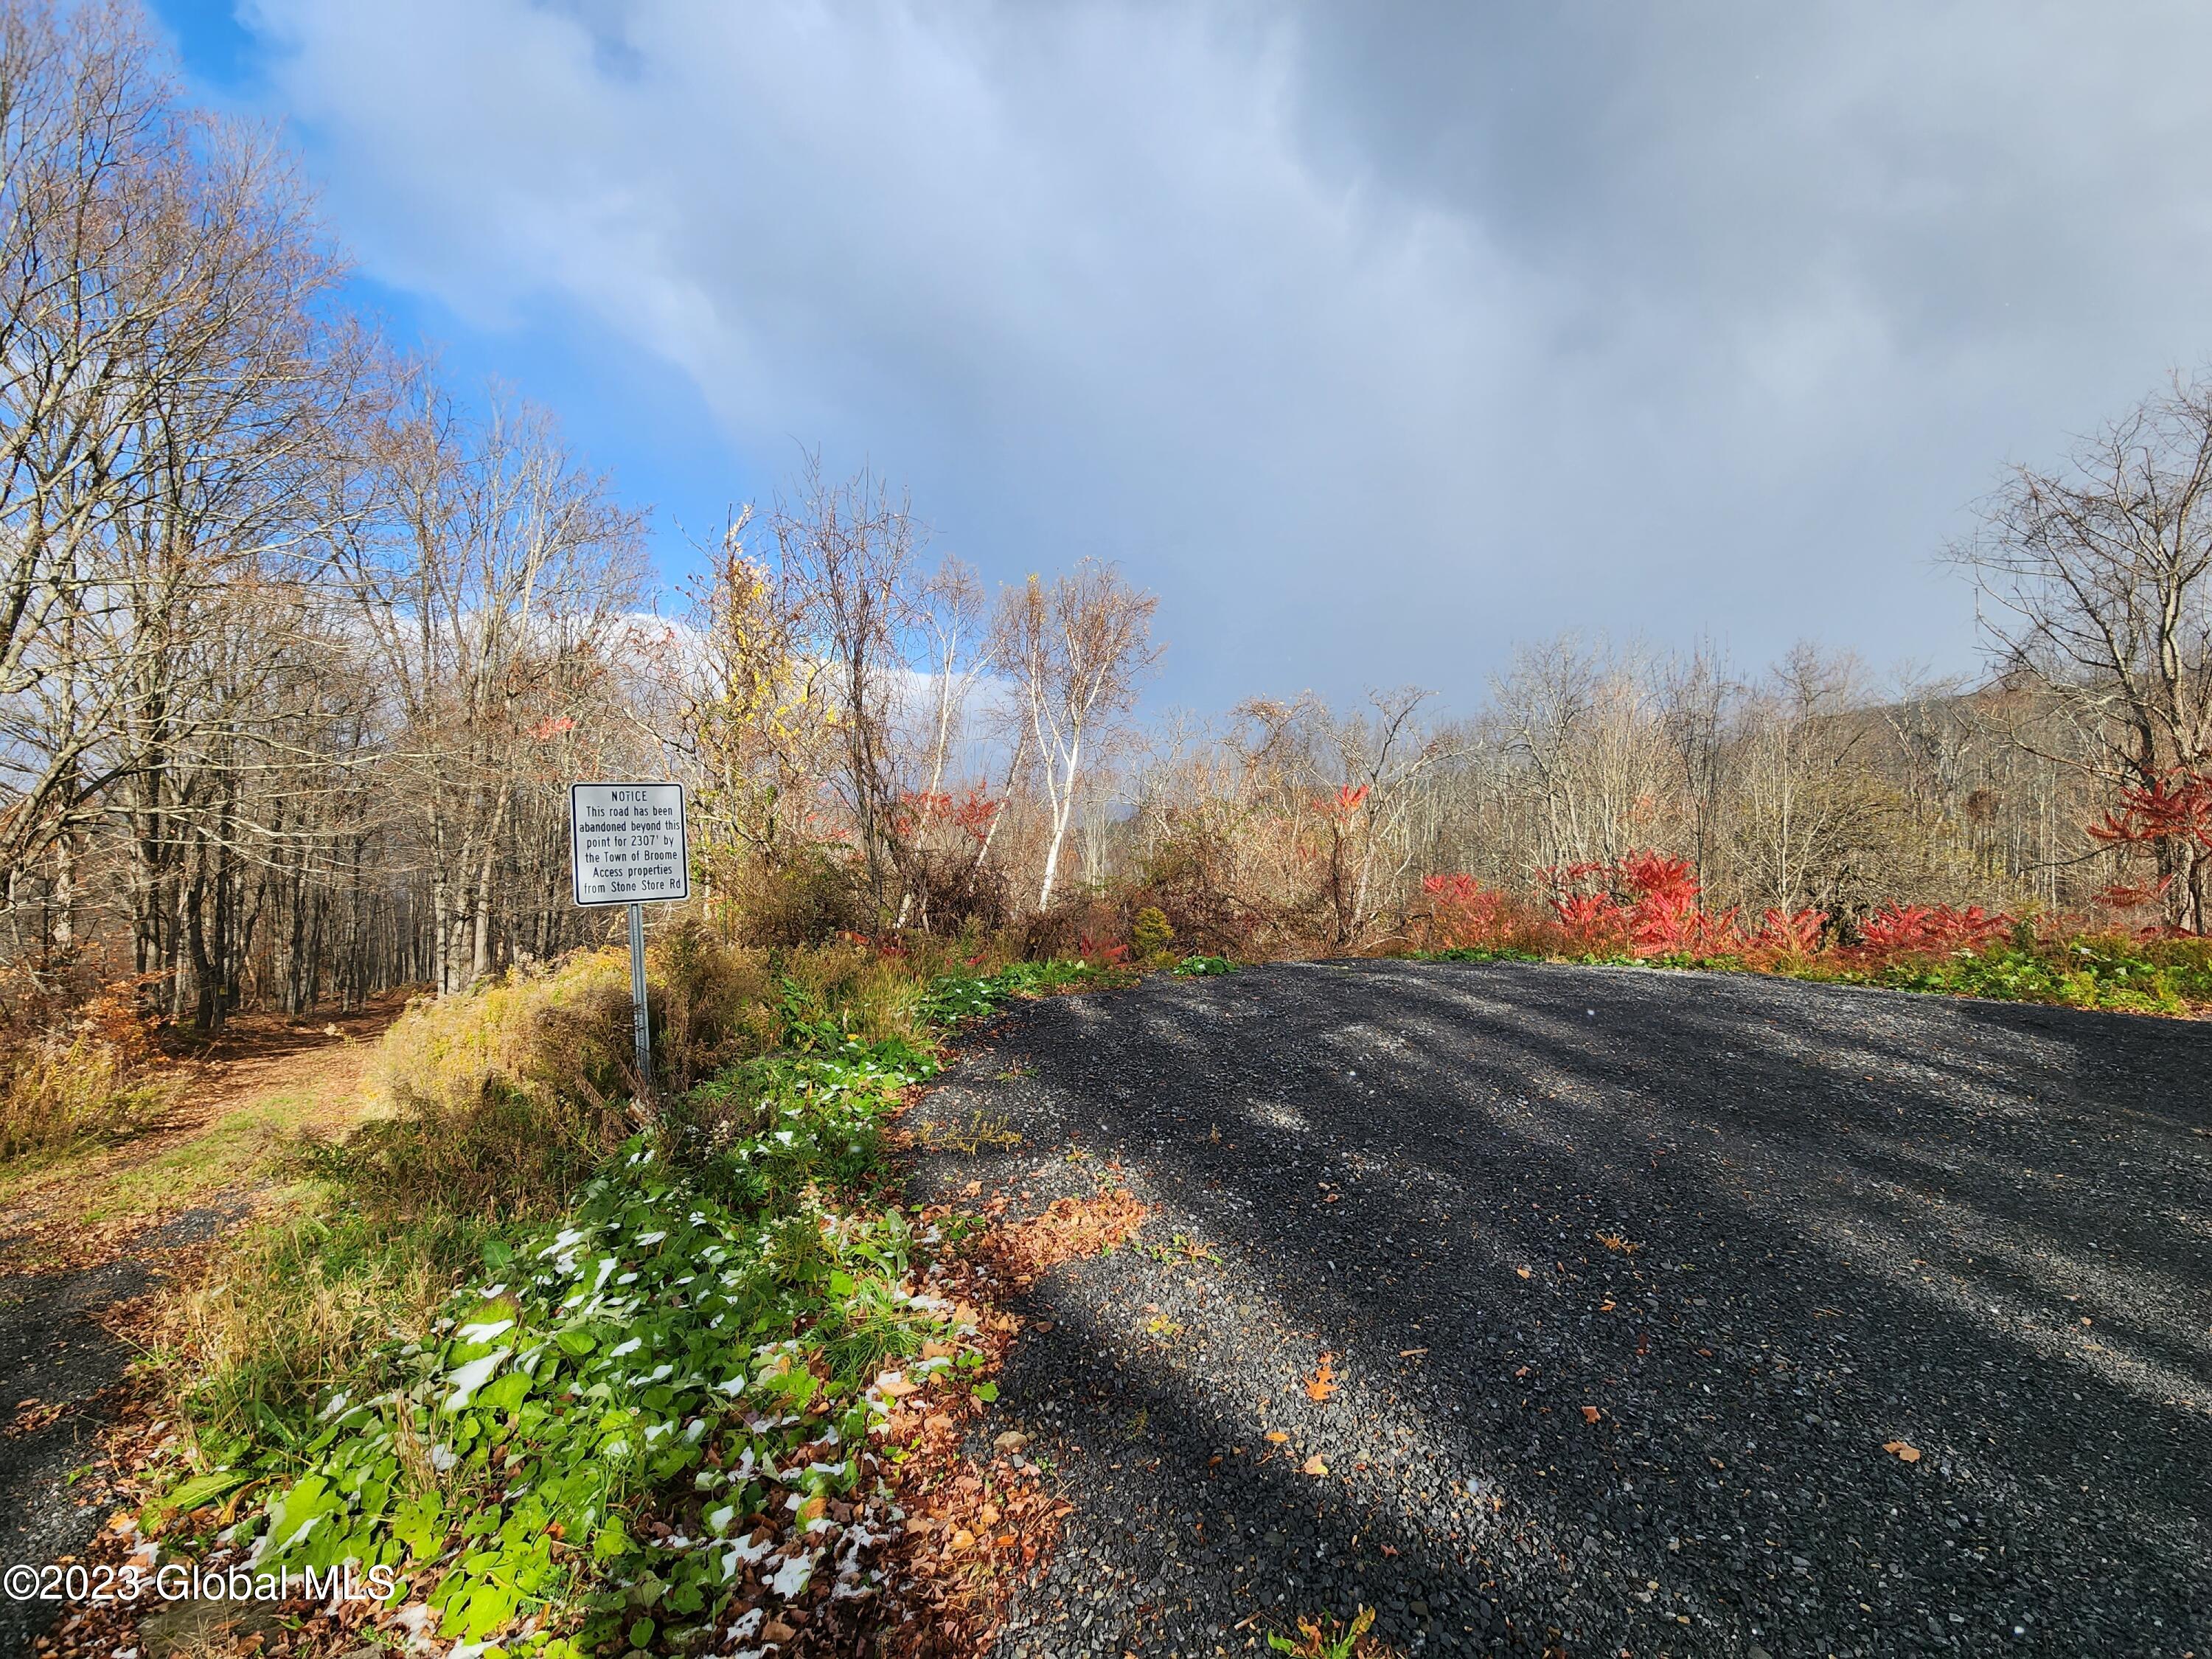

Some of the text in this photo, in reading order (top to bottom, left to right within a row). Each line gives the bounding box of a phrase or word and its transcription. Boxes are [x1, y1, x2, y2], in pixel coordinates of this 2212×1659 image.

[612, 791, 647, 801] NOTICE
[586, 806, 672, 817] This road has been
[580, 821, 680, 833] abandoned beyond this
[587, 837, 610, 849] point
[615, 836, 627, 846] for
[664, 835, 673, 847] by
[585, 851, 677, 863] the Town of Broome
[593, 864, 672, 877] Access properties
[585, 879, 681, 894] from Stone Store Rd
